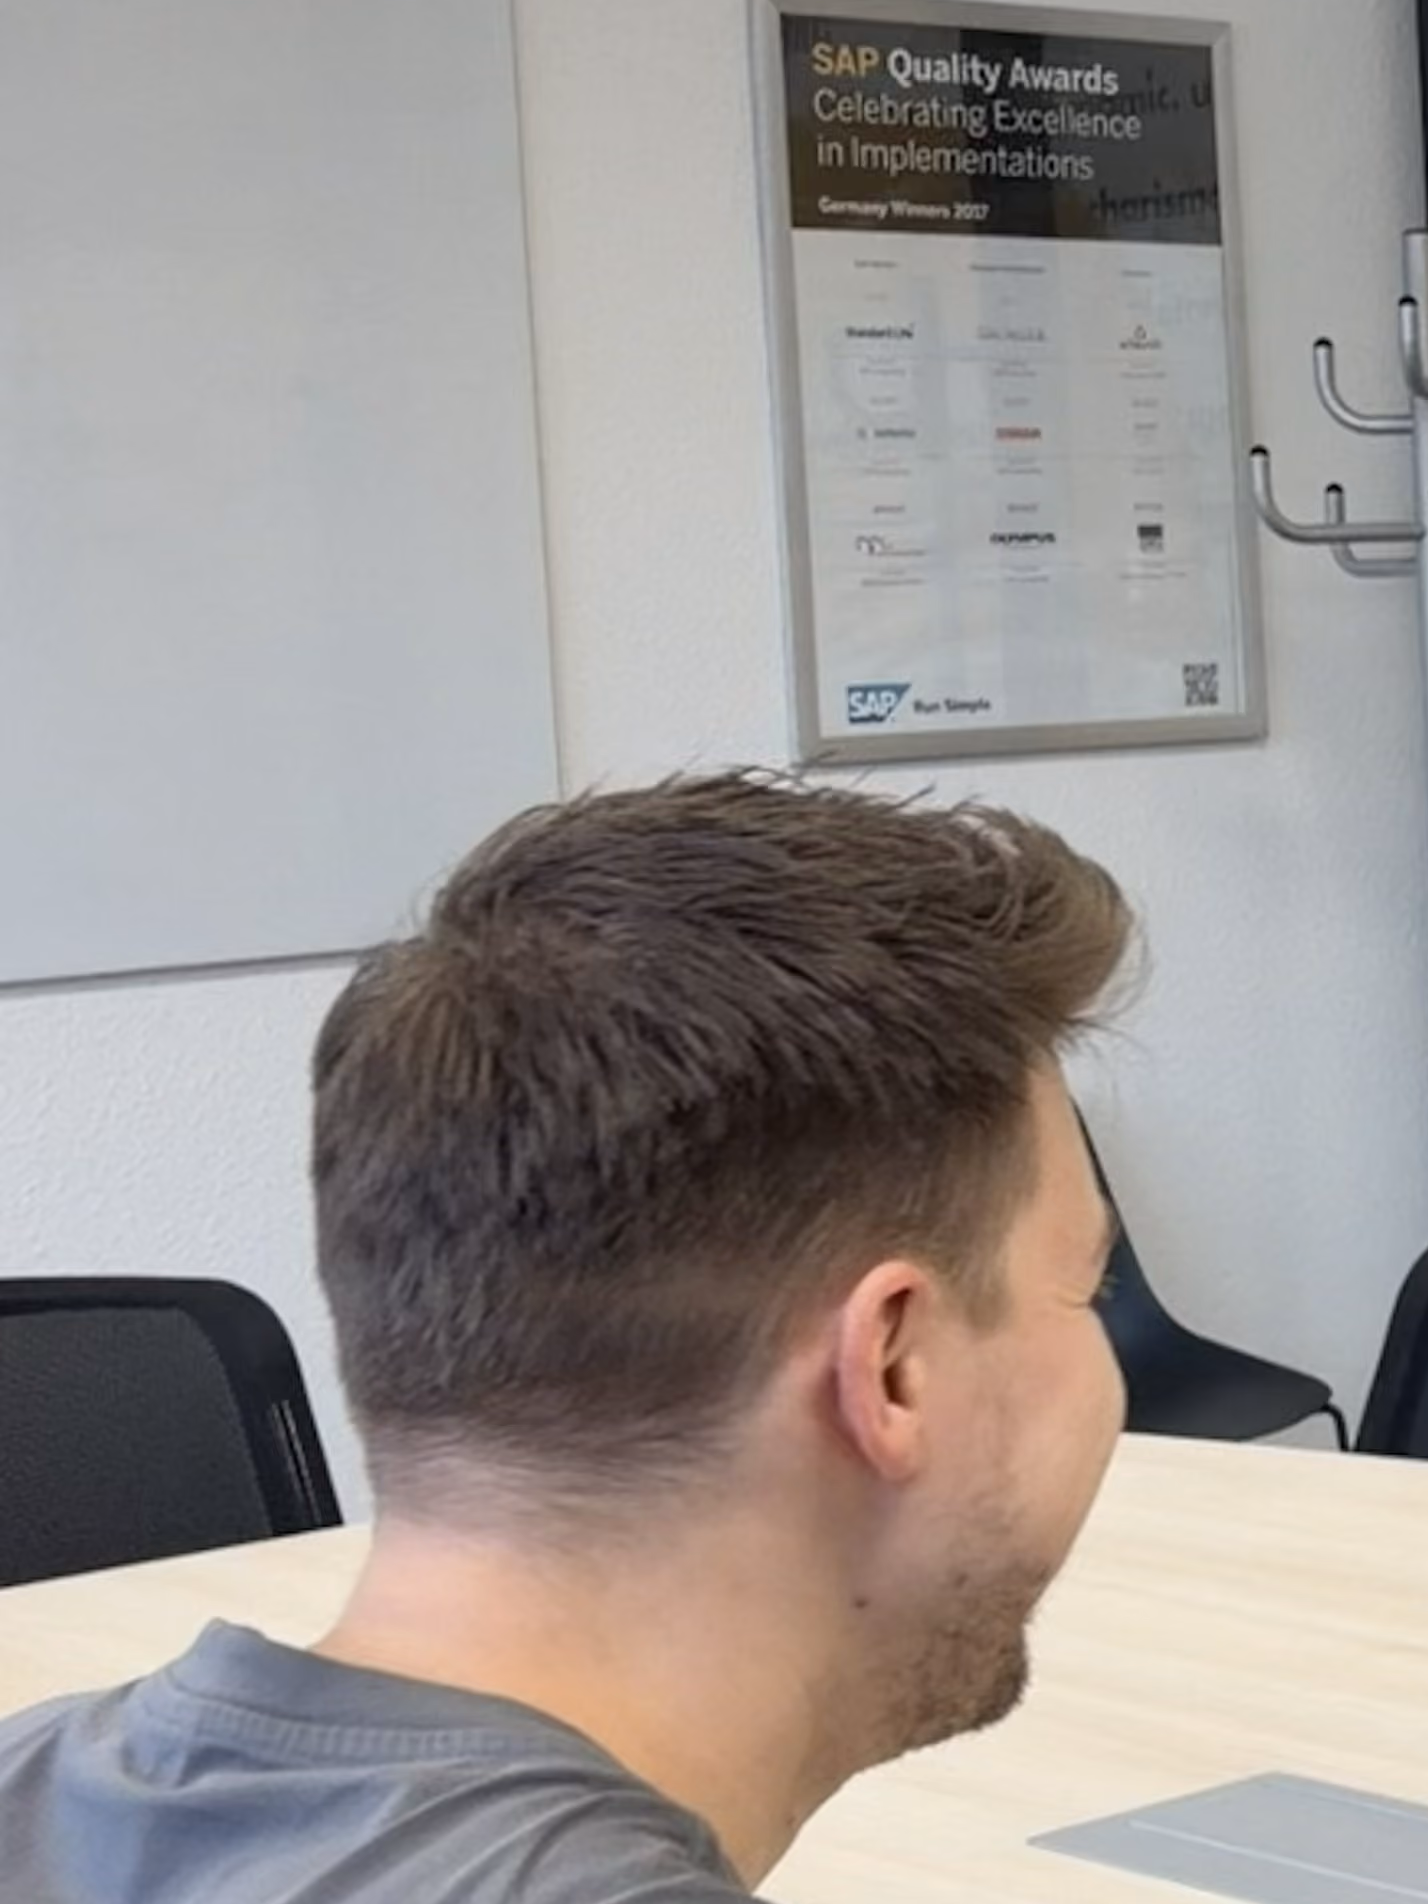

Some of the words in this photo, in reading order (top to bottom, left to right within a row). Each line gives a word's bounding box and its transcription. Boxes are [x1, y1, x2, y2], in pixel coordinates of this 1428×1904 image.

[812, 42, 879, 76] SAP
[887, 48, 1001, 94] Quality
[1009, 58, 1120, 96] Awards
[813, 88, 986, 138] Celebrating
[994, 100, 1142, 140] Excellence
[817, 134, 844, 168] in
[852, 137, 1095, 181] Implementations
[818, 195, 888, 220] Germany
[890, 199, 950, 219] Winners
[849, 688, 902, 720] SAP
